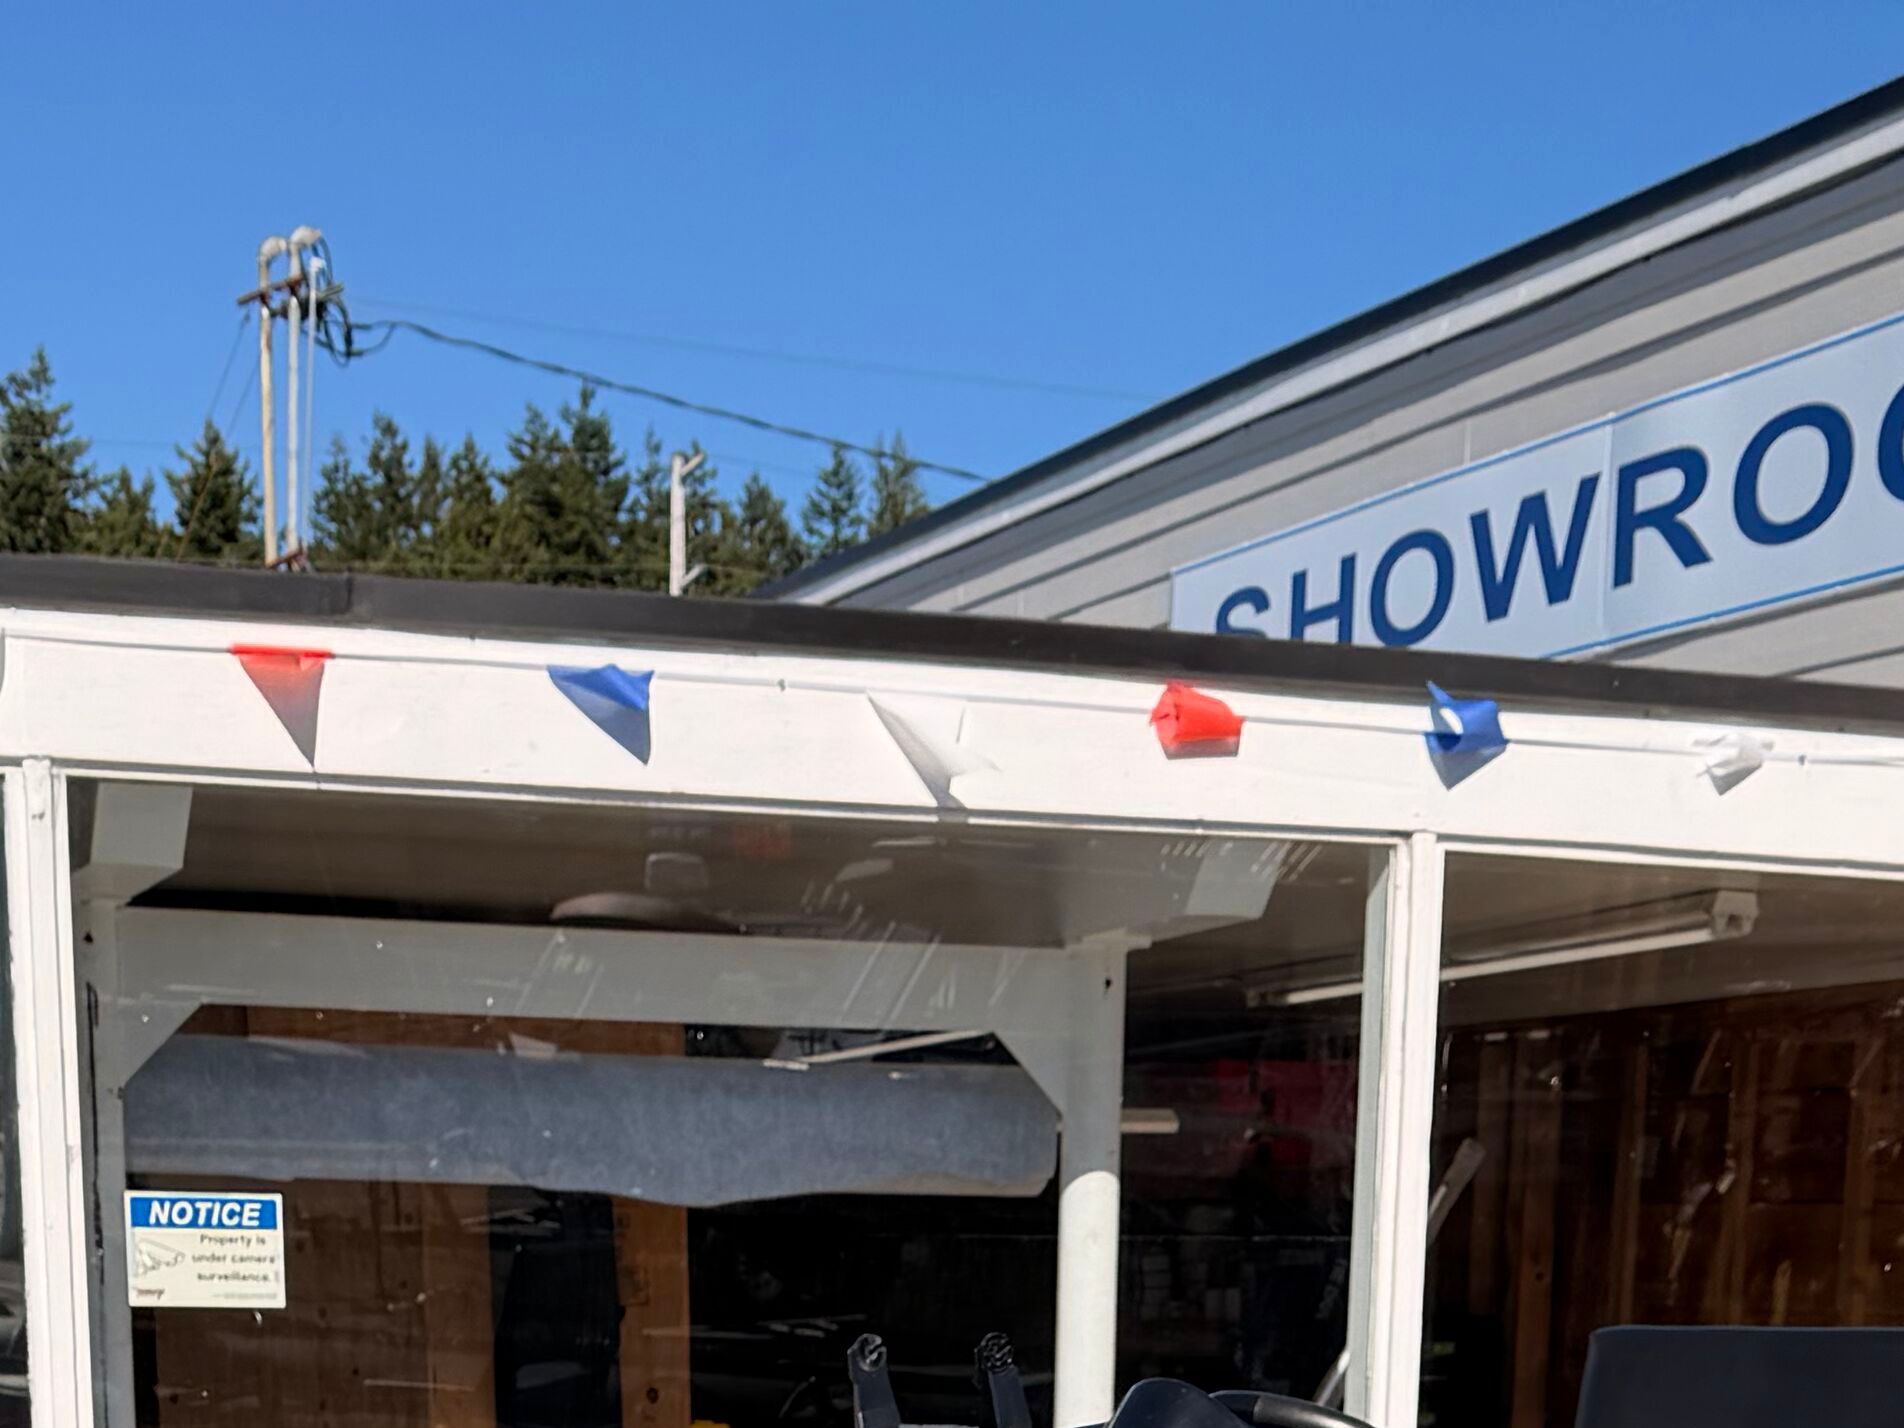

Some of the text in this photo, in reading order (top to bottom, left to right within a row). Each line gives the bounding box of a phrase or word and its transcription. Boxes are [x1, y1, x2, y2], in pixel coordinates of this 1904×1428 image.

[149, 1200, 263, 1227] NOTICE
[199, 1233, 267, 1247] Property is
[192, 1253, 276, 1264] under camera
